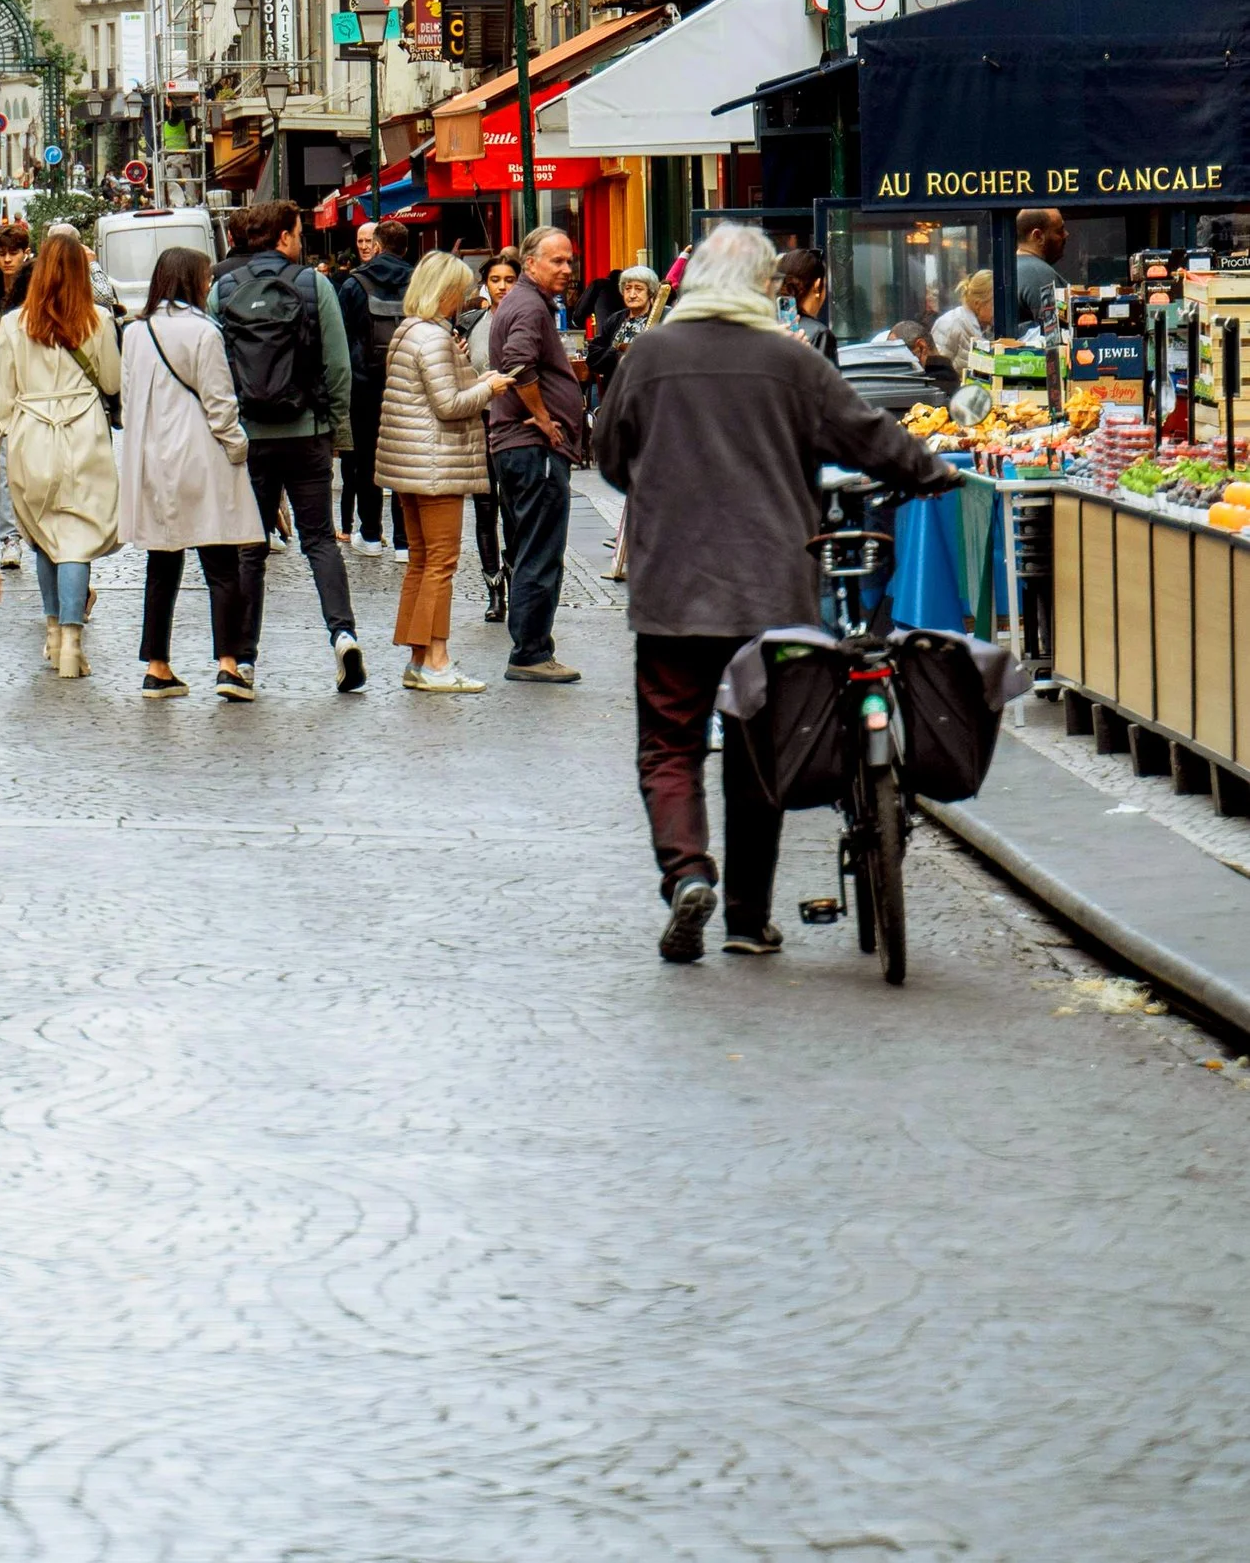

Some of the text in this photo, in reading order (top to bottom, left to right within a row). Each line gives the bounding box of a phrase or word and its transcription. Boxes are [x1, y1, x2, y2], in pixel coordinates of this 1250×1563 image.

[508, 164, 556, 173] Risrante
[878, 165, 1223, 197] AU ROCHER DE CANCALE
[1097, 347, 1139, 364] JEWEL
